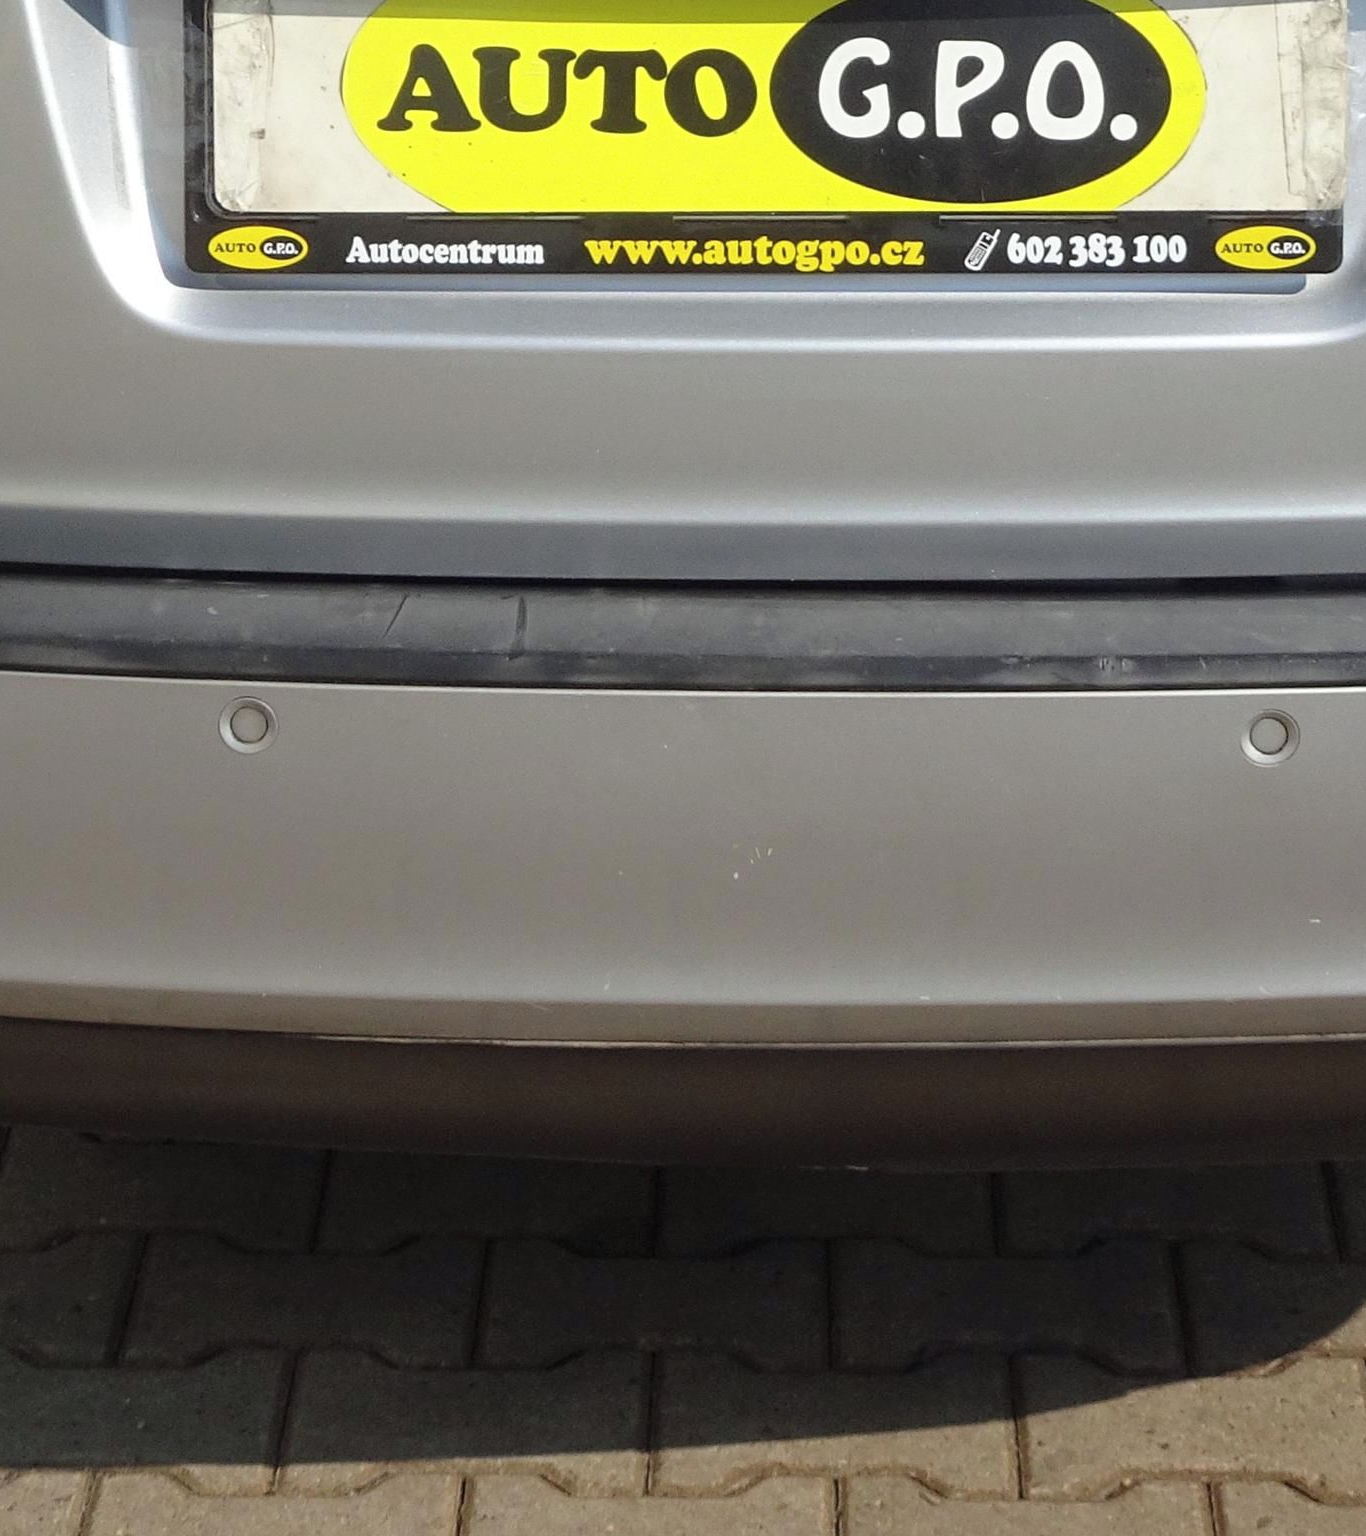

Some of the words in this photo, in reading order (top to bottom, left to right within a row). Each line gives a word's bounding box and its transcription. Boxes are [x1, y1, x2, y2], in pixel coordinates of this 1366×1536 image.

[376, 43, 758, 138] AUTO
[818, 37, 1138, 141] G.P.O.
[214, 242, 257, 254] AUTO
[263, 242, 299, 255] G.P.O.
[346, 236, 545, 265] Autocentrum
[584, 236, 924, 272] www.autogpo.cz
[1007, 233, 1063, 266] 602
[1068, 232, 1126, 267] 383
[1132, 235, 1188, 264] 100
[1220, 243, 1264, 254] AUTO
[1269, 242, 1306, 255] G.P.O.
